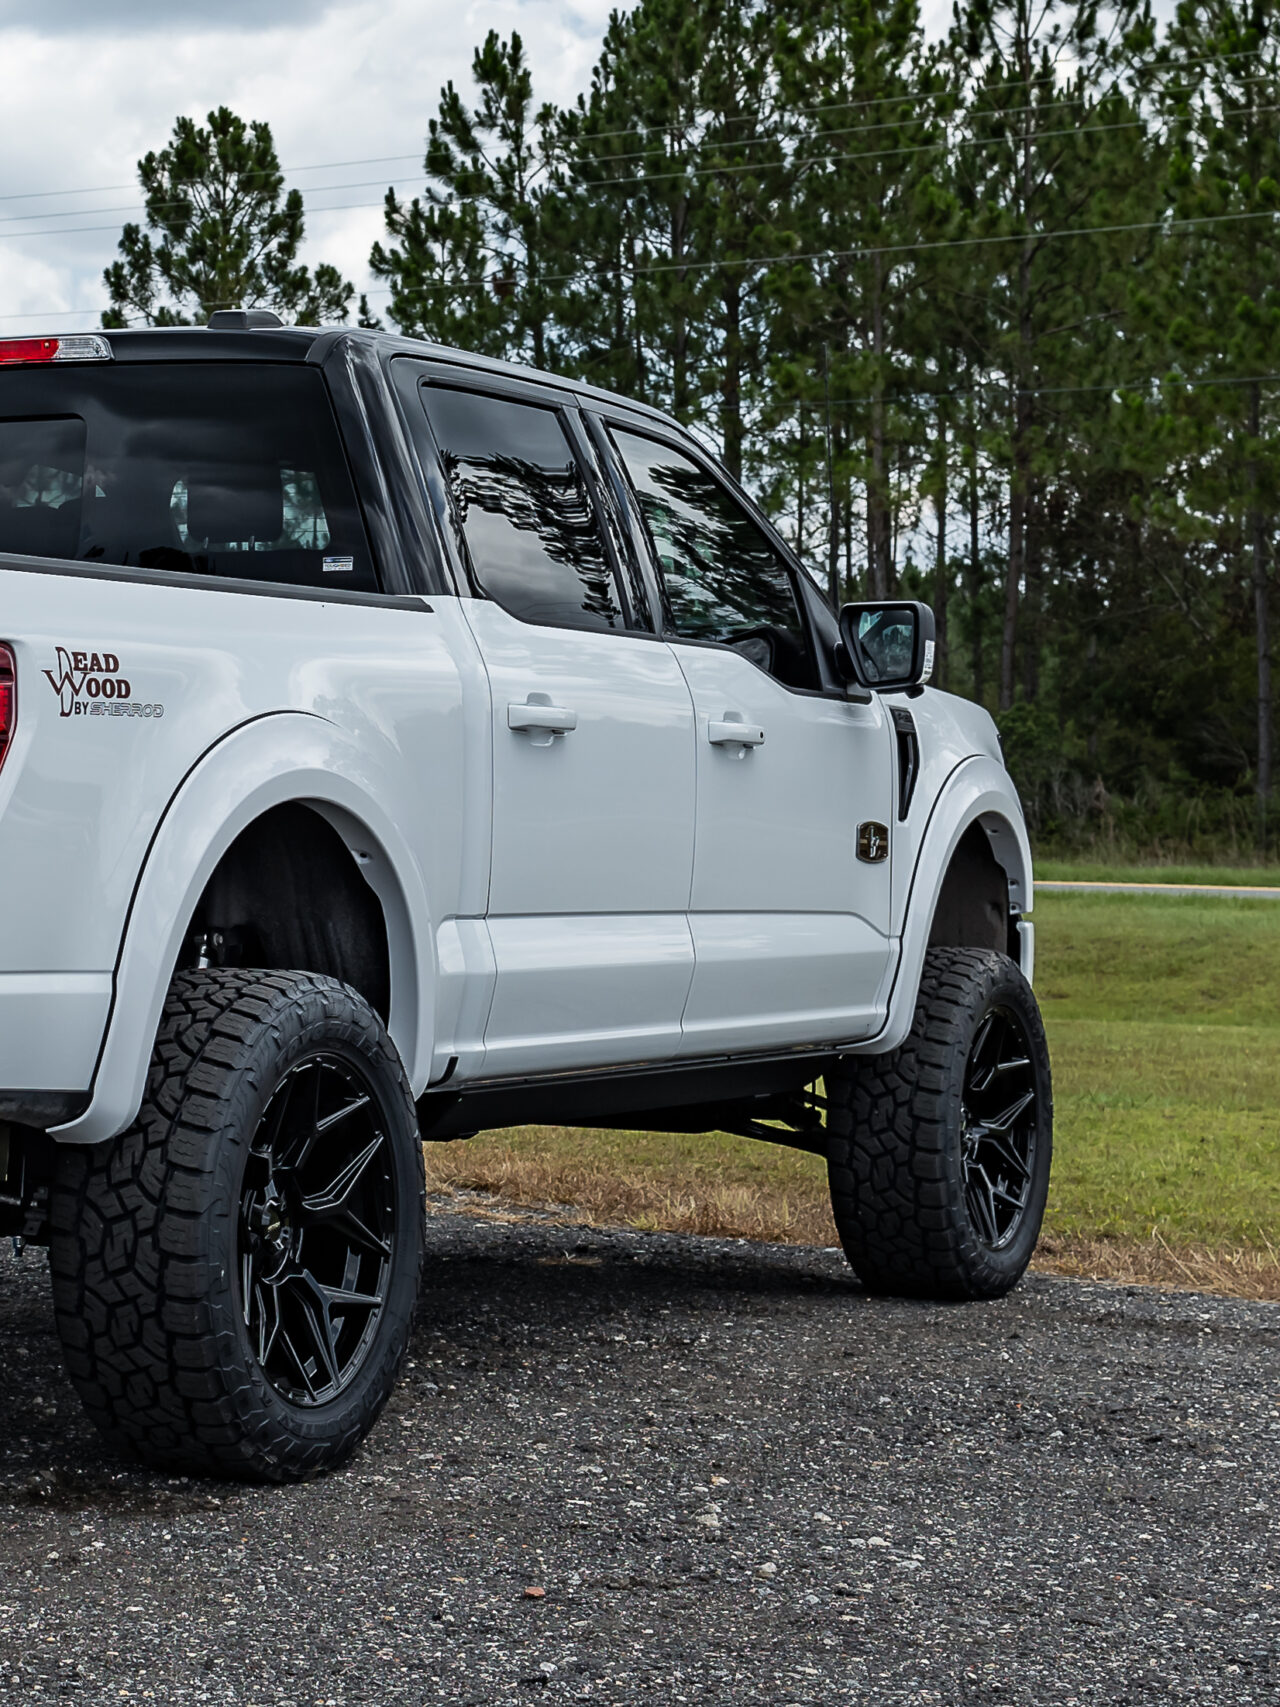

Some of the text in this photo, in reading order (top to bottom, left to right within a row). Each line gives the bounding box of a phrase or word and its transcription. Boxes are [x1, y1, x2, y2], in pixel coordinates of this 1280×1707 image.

[41, 670, 131, 698] WOOD
[55, 646, 119, 717] DEAD
[74, 701, 164, 718] BY SHERROD
